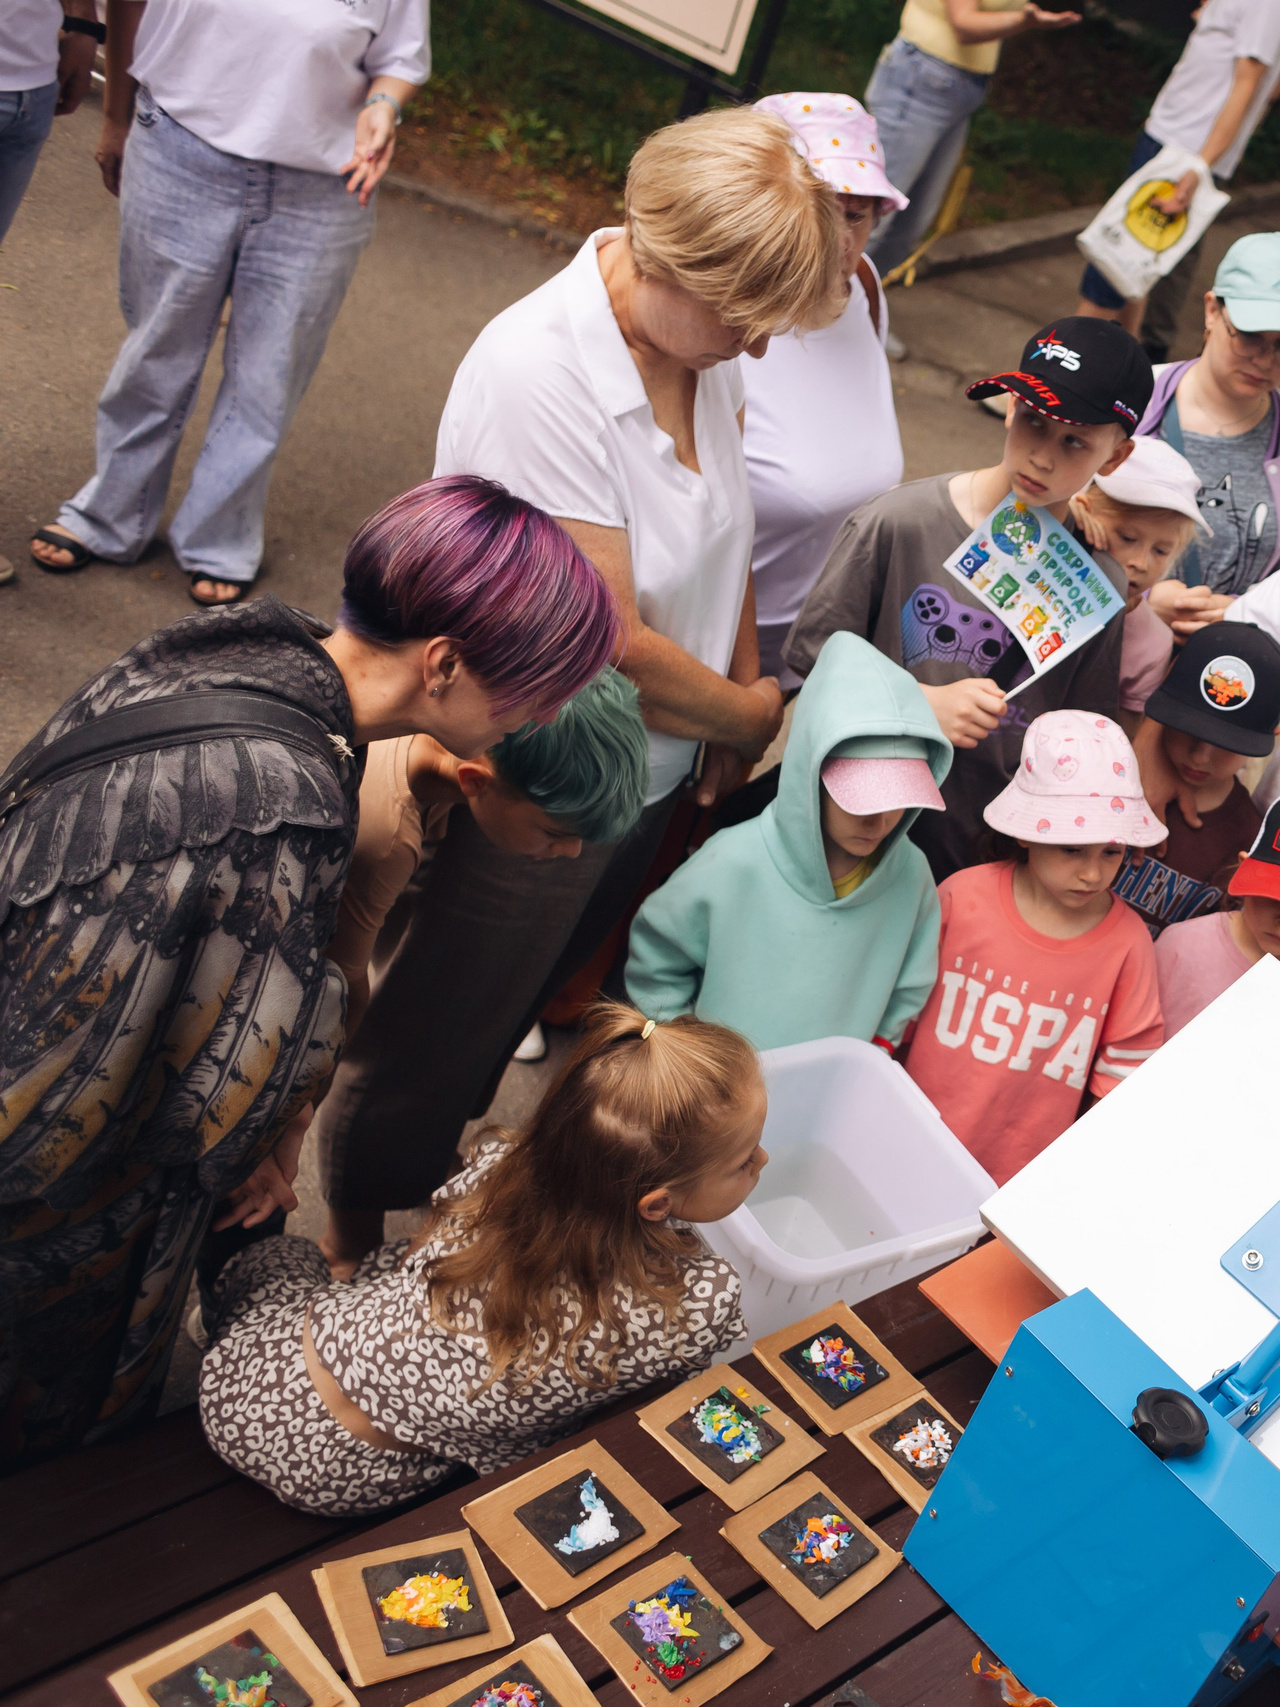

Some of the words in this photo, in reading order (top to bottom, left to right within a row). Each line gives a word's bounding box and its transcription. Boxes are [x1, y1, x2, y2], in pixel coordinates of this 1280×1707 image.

[1025, 569, 1077, 629] ВМЕСТЕ
[1037, 550, 1095, 617] ПРИРОДУ
[1047, 532, 1113, 608] СОХРАНИМ
[954, 956, 1029, 995] SINCE
[934, 970, 1097, 1090] USPA
